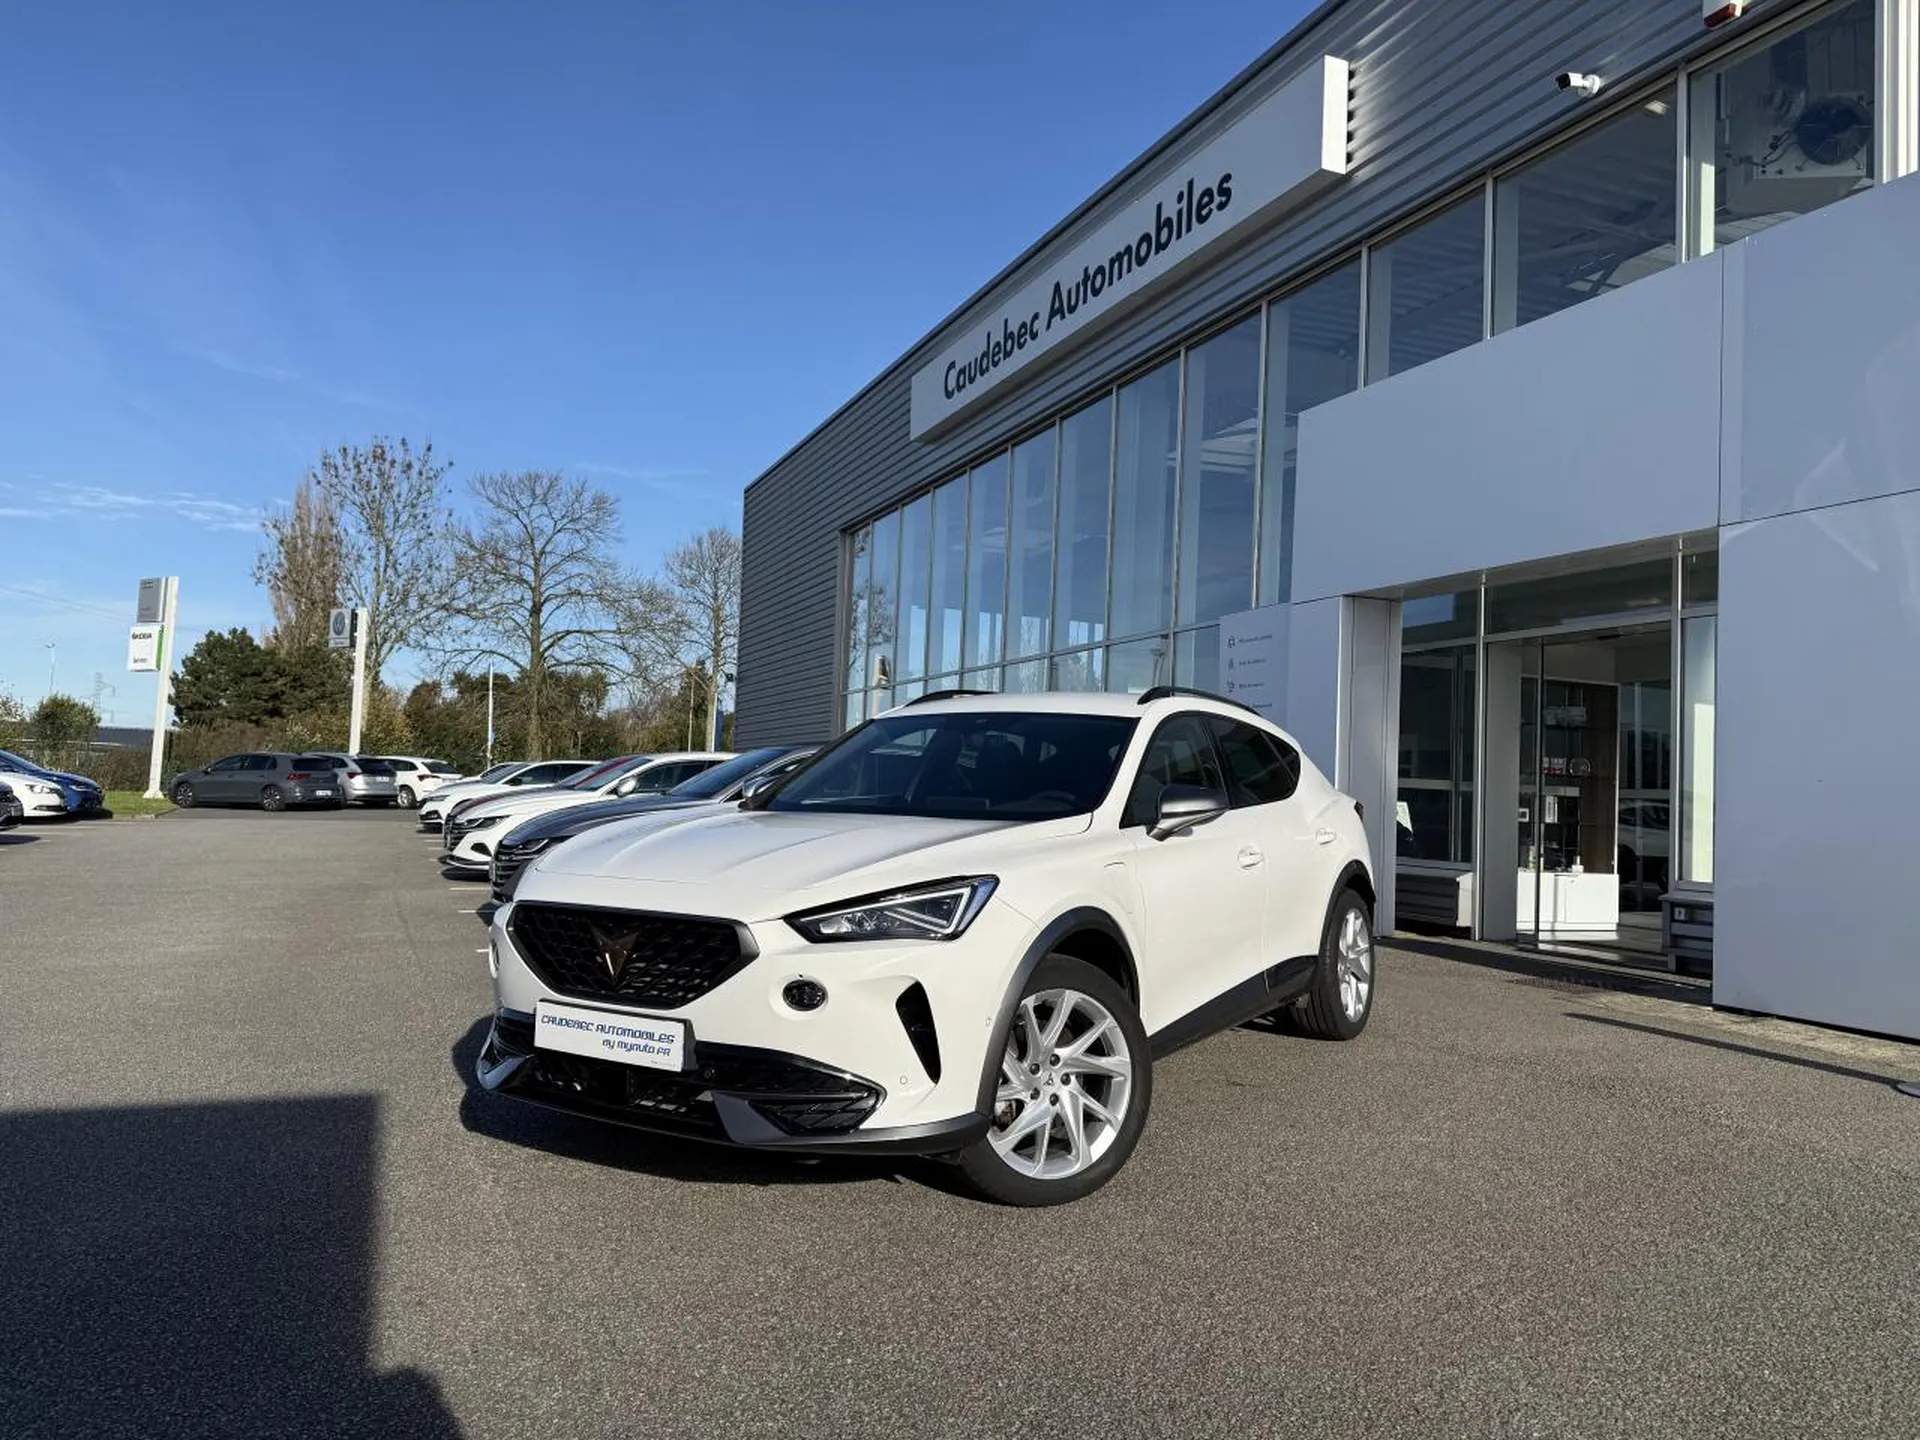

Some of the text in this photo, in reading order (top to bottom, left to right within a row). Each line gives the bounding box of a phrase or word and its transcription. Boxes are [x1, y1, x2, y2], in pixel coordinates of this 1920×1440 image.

[944, 172, 1233, 400] Caudebec Automobiles
[541, 1014, 675, 1044] CAUDEBEC AUTOMOBILES
